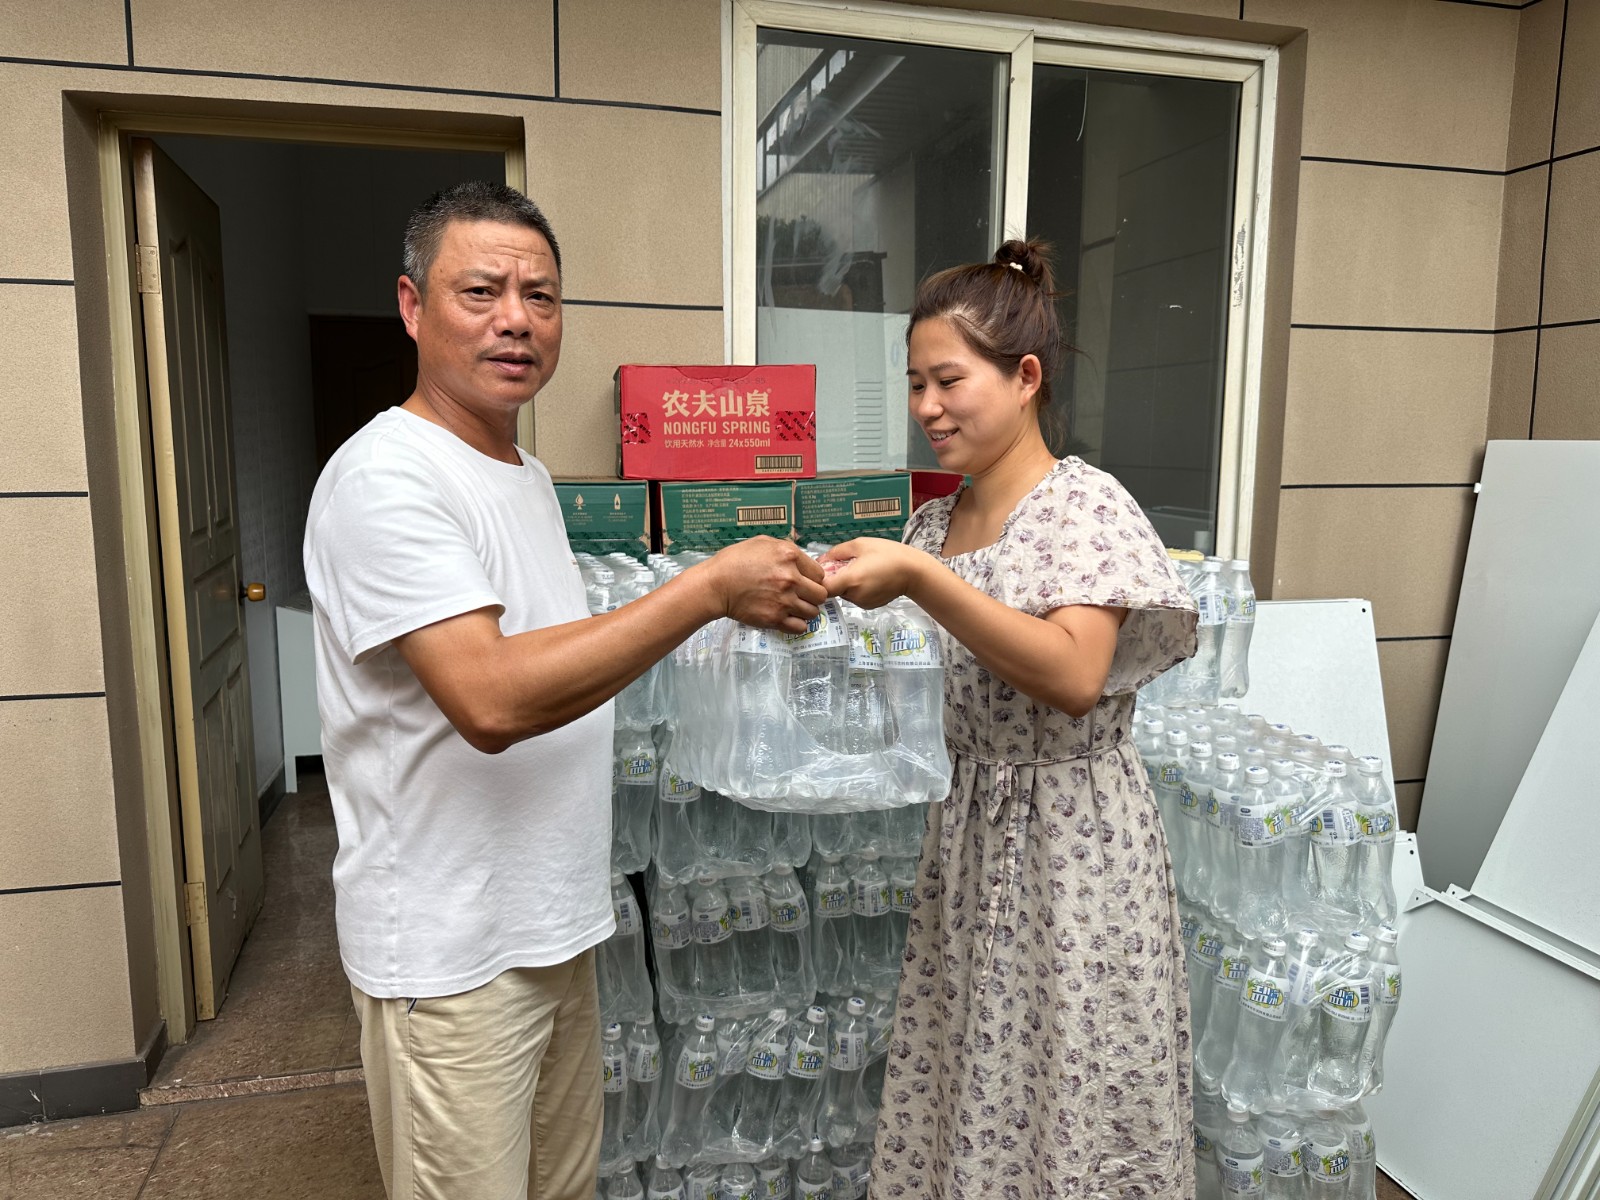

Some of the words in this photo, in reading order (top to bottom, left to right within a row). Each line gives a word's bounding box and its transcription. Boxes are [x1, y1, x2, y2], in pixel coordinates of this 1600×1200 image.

[662, 389, 770, 418] 农夫山泉
[664, 421, 717, 436] NONGFU
[722, 420, 771, 435] SPRING
[665, 438, 705, 449] 饮用天然水
[728, 437, 771, 449] 24x550ml
